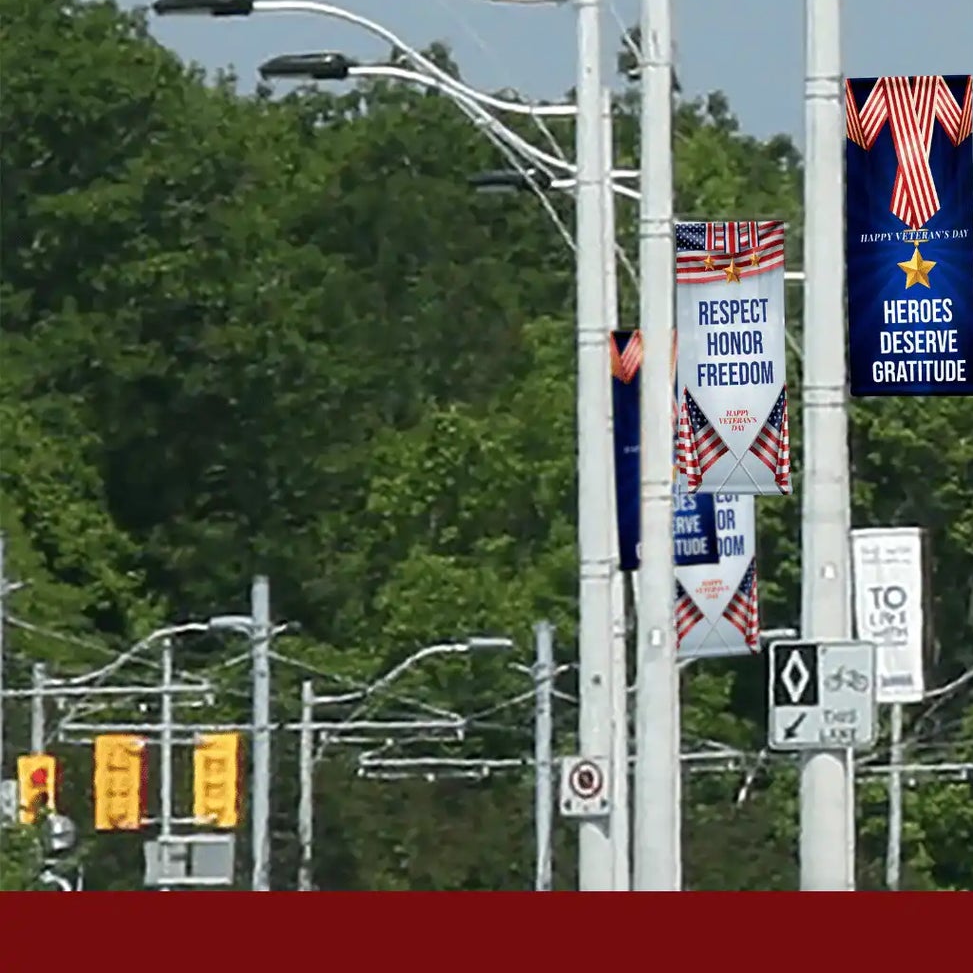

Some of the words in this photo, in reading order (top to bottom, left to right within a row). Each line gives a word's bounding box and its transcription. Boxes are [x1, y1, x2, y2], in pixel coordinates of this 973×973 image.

[860, 231, 893, 243] HAPPY
[895, 230, 950, 241] VETERAN'S
[952, 229, 969, 239] DAY
[698, 298, 769, 326] RESPECT
[883, 298, 953, 324] HEROES
[707, 330, 763, 356] HONOR
[880, 329, 958, 354] DESERVE
[697, 360, 774, 387] FREEDOM
[872, 360, 967, 383] GRATITUDE
[868, 585, 907, 610] TO
